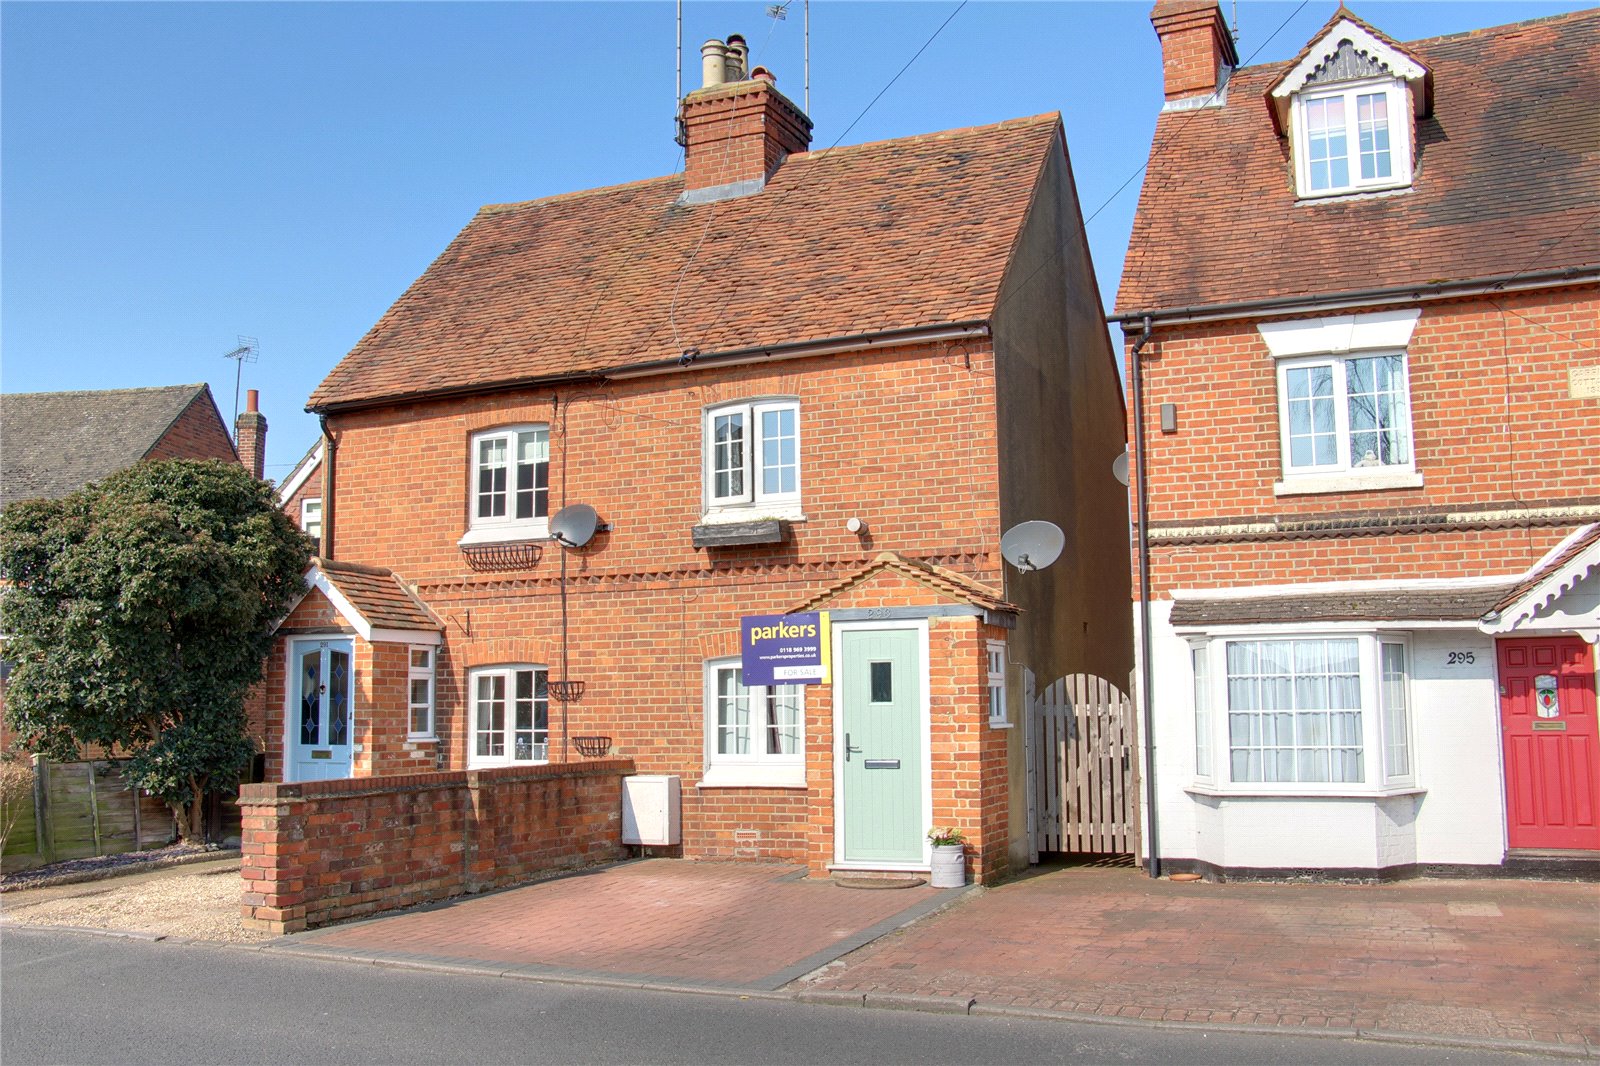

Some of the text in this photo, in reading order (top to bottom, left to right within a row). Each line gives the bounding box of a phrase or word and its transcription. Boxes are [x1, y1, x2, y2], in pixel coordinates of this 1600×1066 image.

[751, 621, 816, 645] parkers
[1446, 651, 1475, 665] 295
[783, 668, 816, 677] FOR SALE
